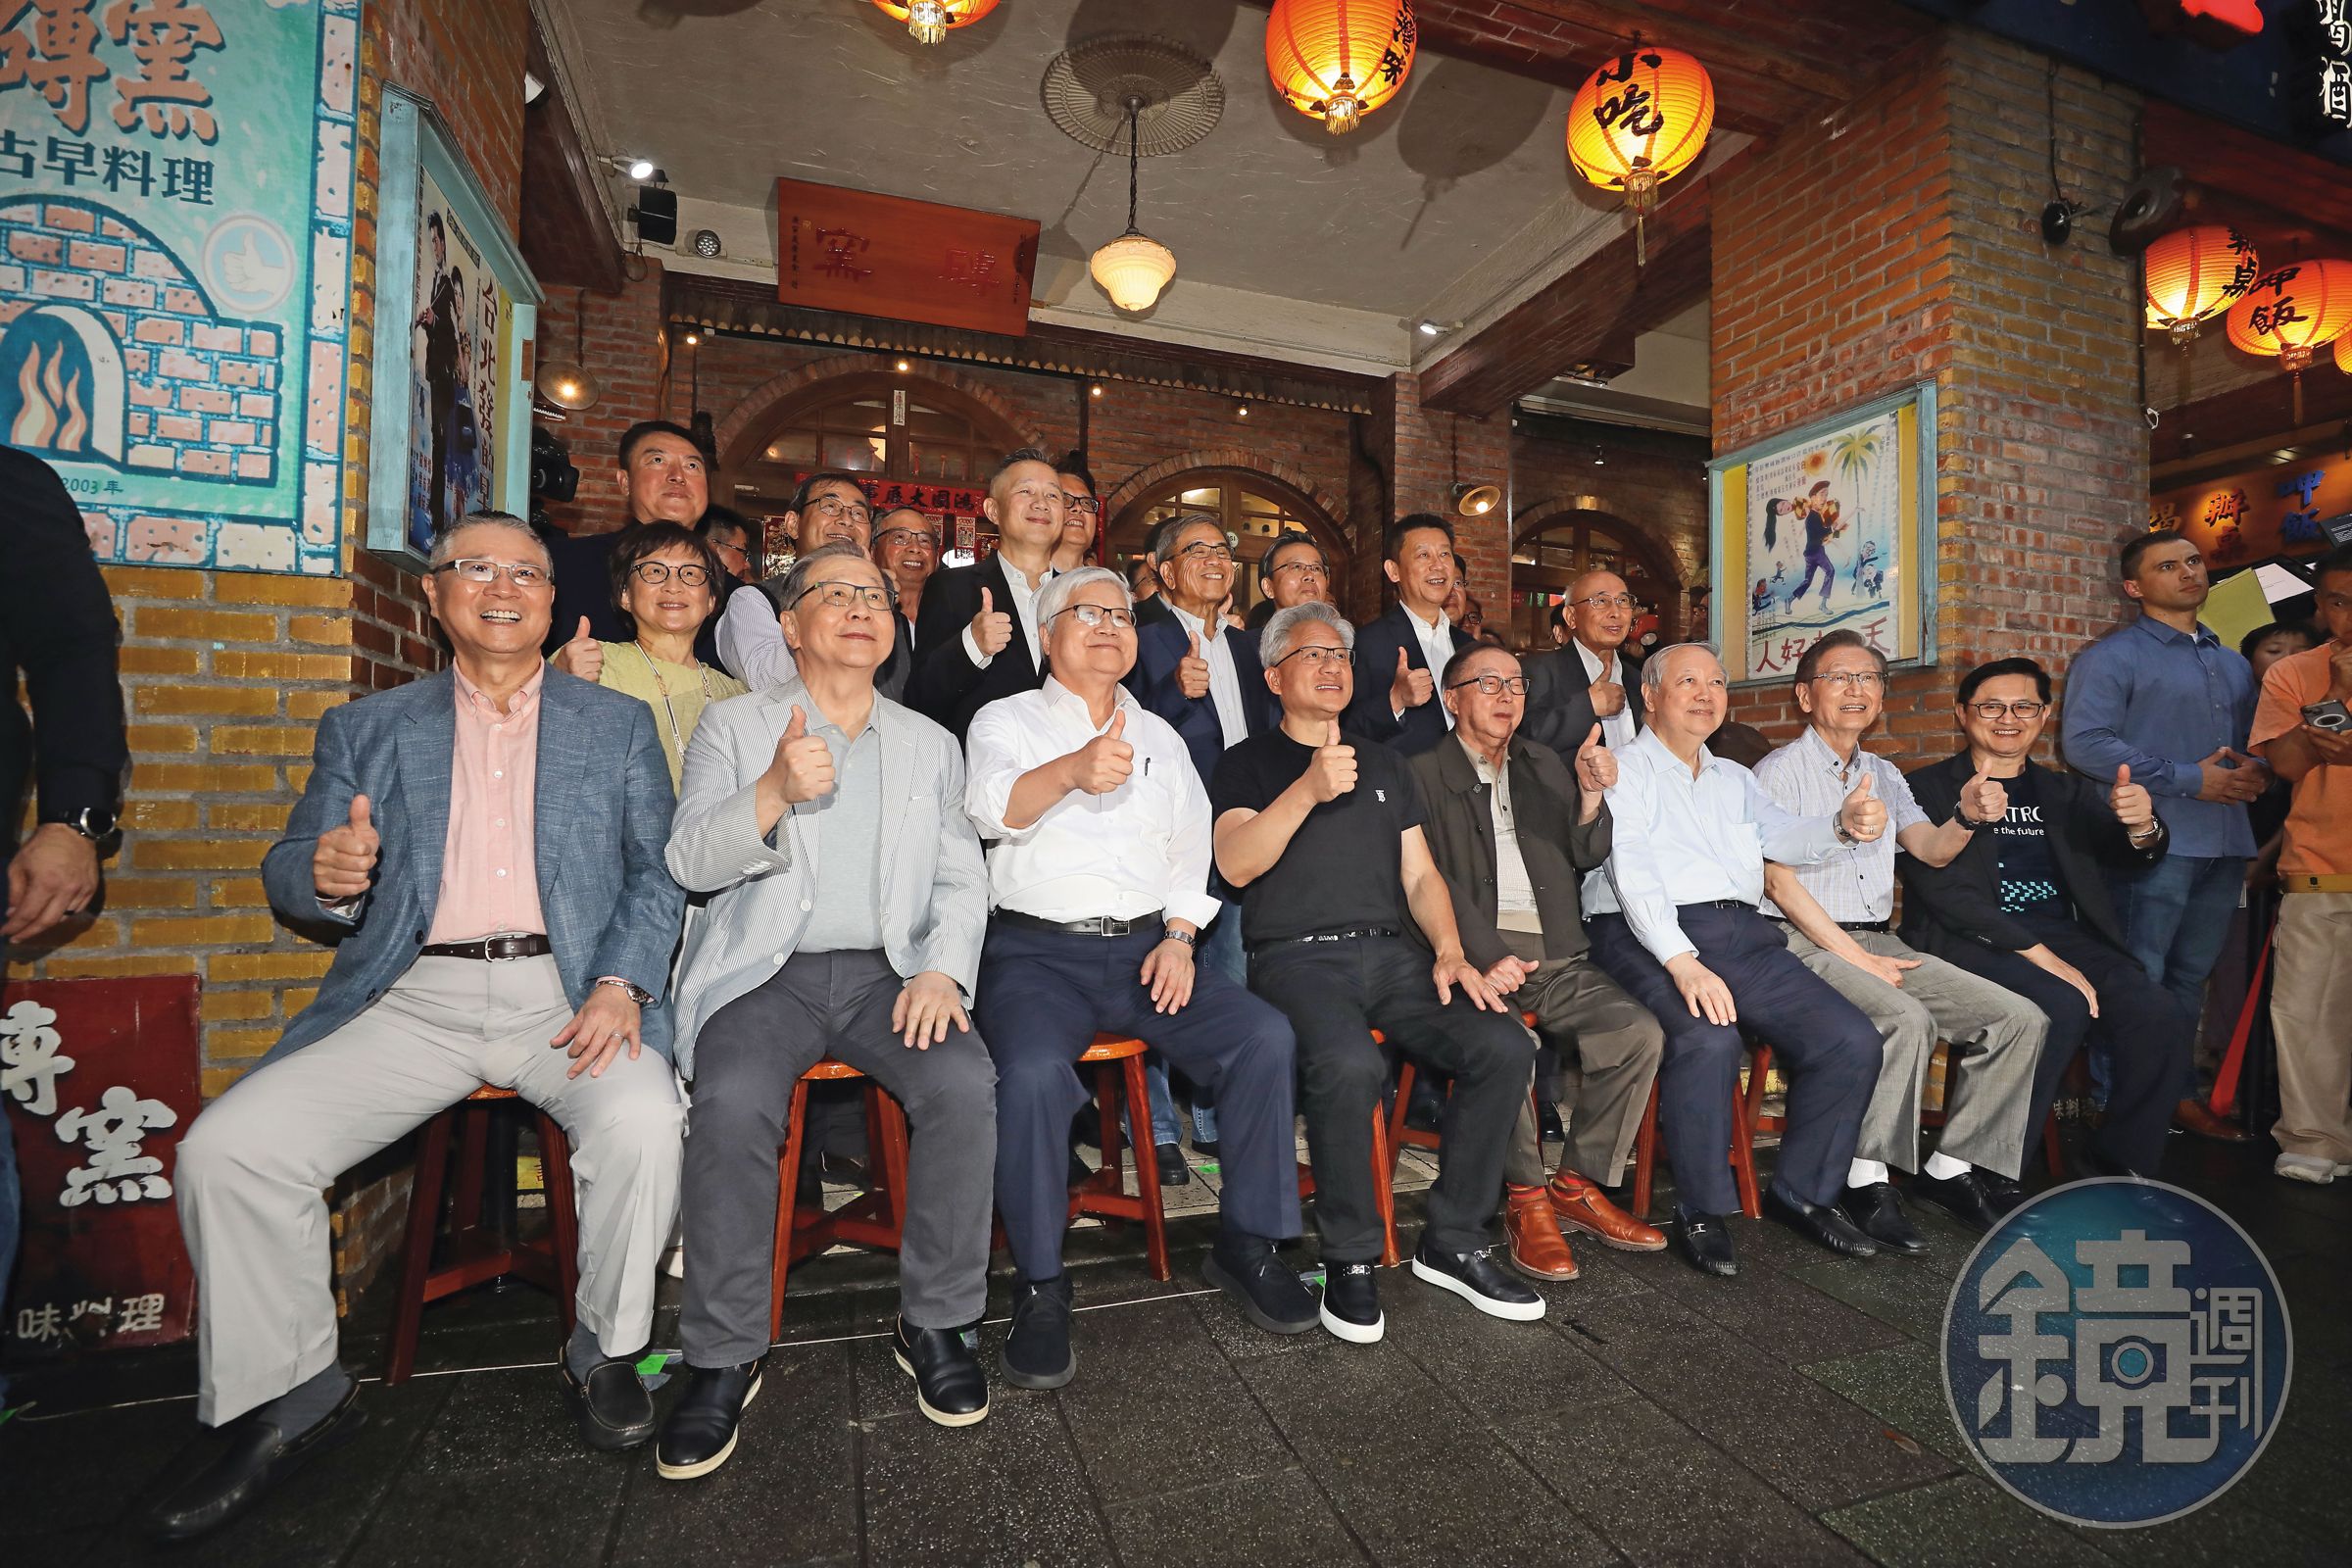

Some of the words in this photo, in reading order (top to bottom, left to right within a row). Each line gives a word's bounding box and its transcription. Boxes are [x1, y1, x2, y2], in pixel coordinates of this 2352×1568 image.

[1593, 53, 1664, 137] 小吃
[2001, 826, 2016, 835] the
[2017, 827, 2045, 836] future
